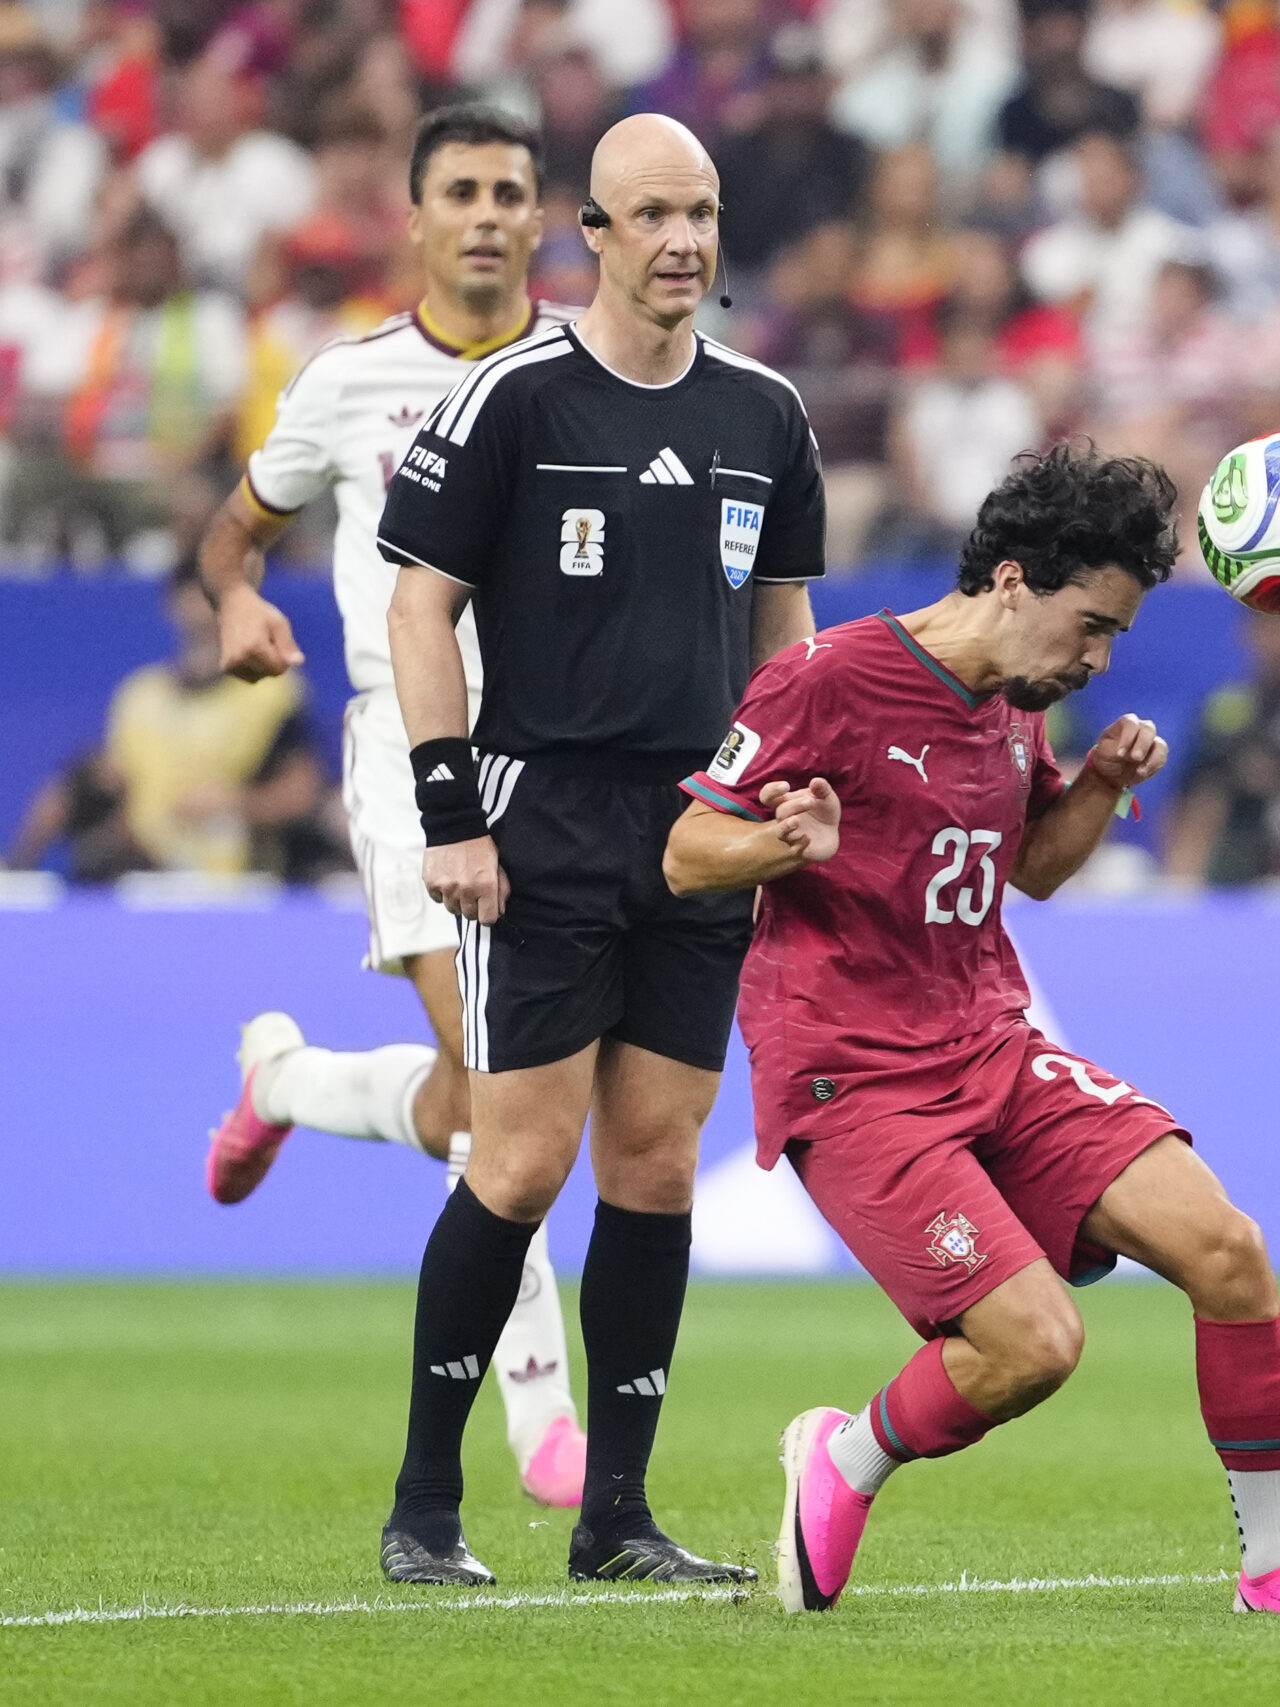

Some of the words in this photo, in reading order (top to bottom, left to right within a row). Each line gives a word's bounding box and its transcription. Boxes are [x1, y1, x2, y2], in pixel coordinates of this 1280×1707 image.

[408, 445, 447, 478] FIFA
[421, 477, 441, 493] ONE
[726, 505, 759, 531] FIFA
[724, 540, 755, 555] REFEREE
[730, 569, 745, 580] 2026
[925, 826, 1002, 926] 23
[1031, 1053, 1132, 1105] 2
